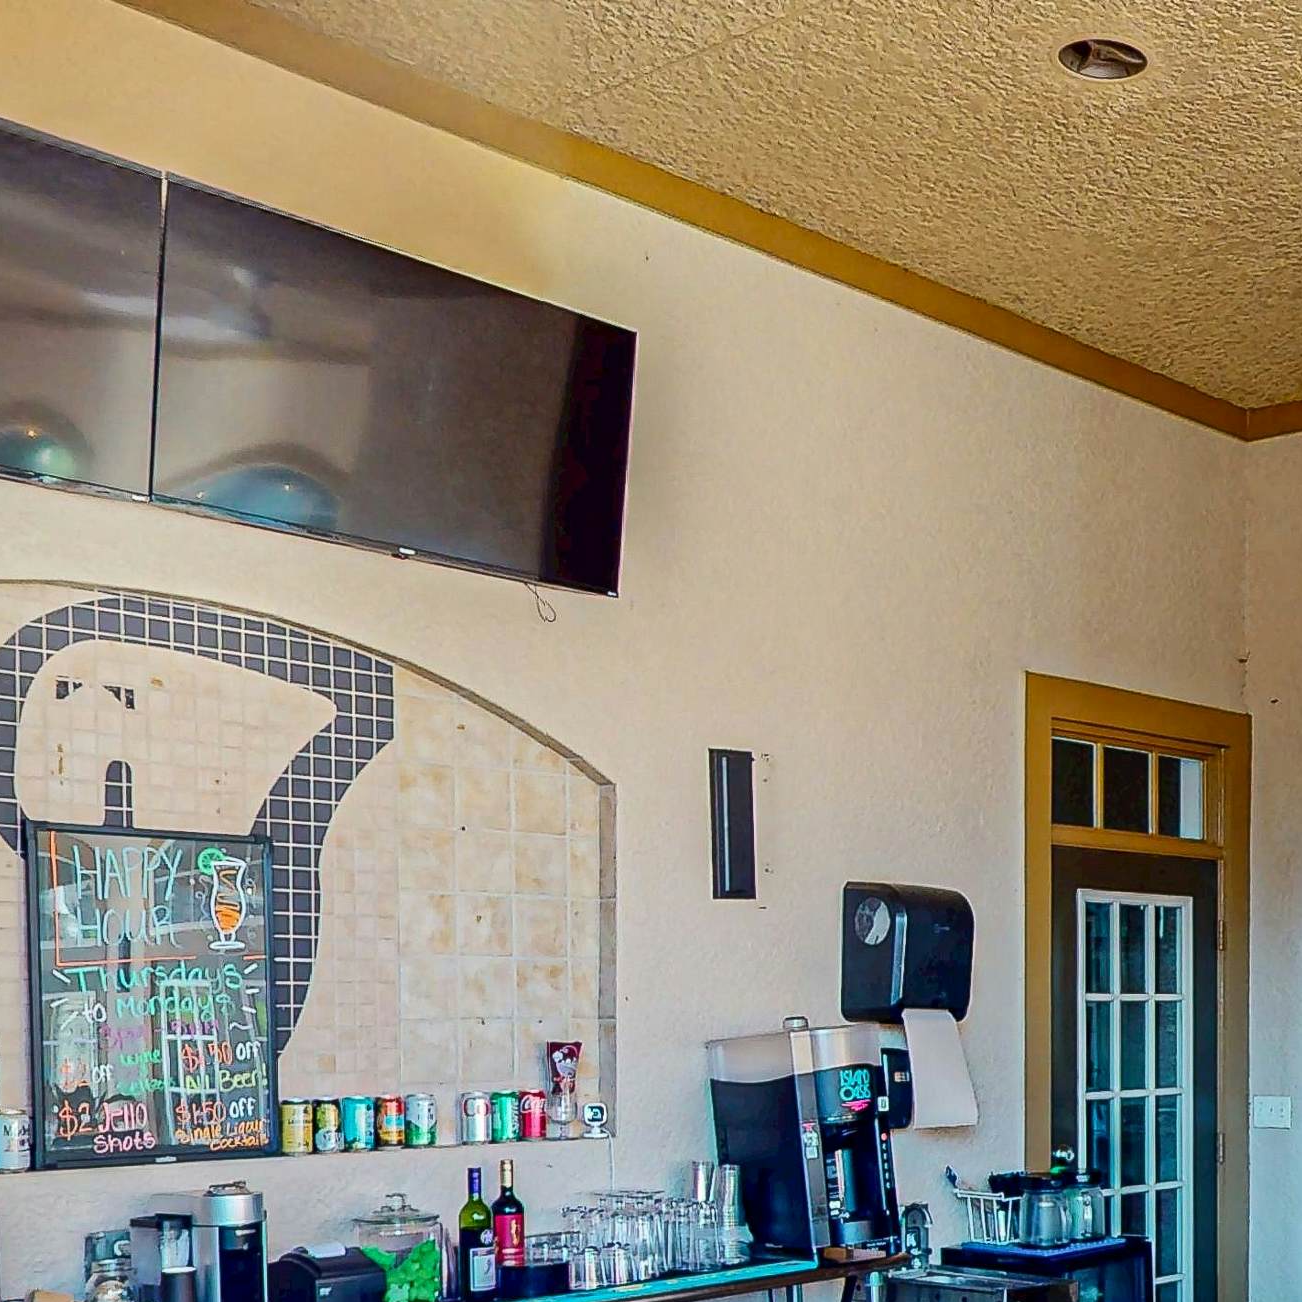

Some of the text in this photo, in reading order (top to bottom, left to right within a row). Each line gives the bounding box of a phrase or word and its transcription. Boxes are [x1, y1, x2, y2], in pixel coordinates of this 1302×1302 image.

[72, 844, 183, 901] HAPPY
[76, 904, 184, 950] HOUR
[58, 1100, 93, 1141] $2
